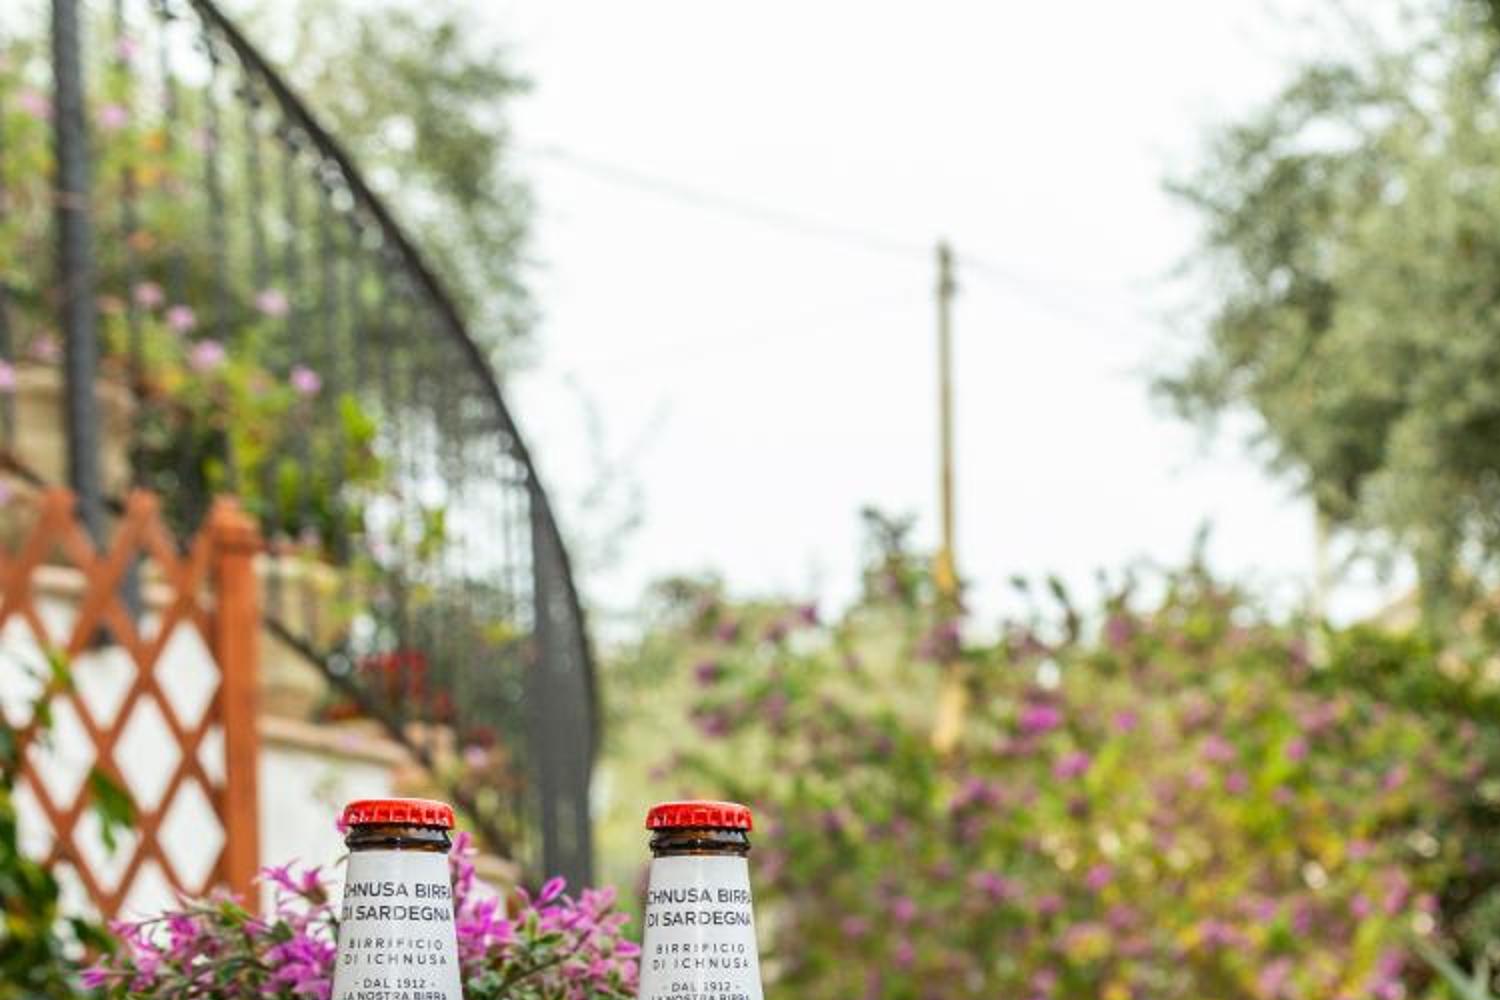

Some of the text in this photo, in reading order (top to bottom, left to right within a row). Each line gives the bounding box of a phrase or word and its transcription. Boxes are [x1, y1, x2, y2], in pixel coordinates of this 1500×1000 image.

[648, 913, 659, 927] DI
[349, 938, 443, 950] BIRRIFICIO
[655, 943, 745, 955] BIRRIFICIO
[344, 953, 447, 965] DI ICHNUSA
[653, 958, 748, 971] DI ICHNUSA
[363, 978, 426, 989] DAL 1912
[671, 981, 731, 992] DAL 1912
[357, 990, 409, 1000] NOSTRA
